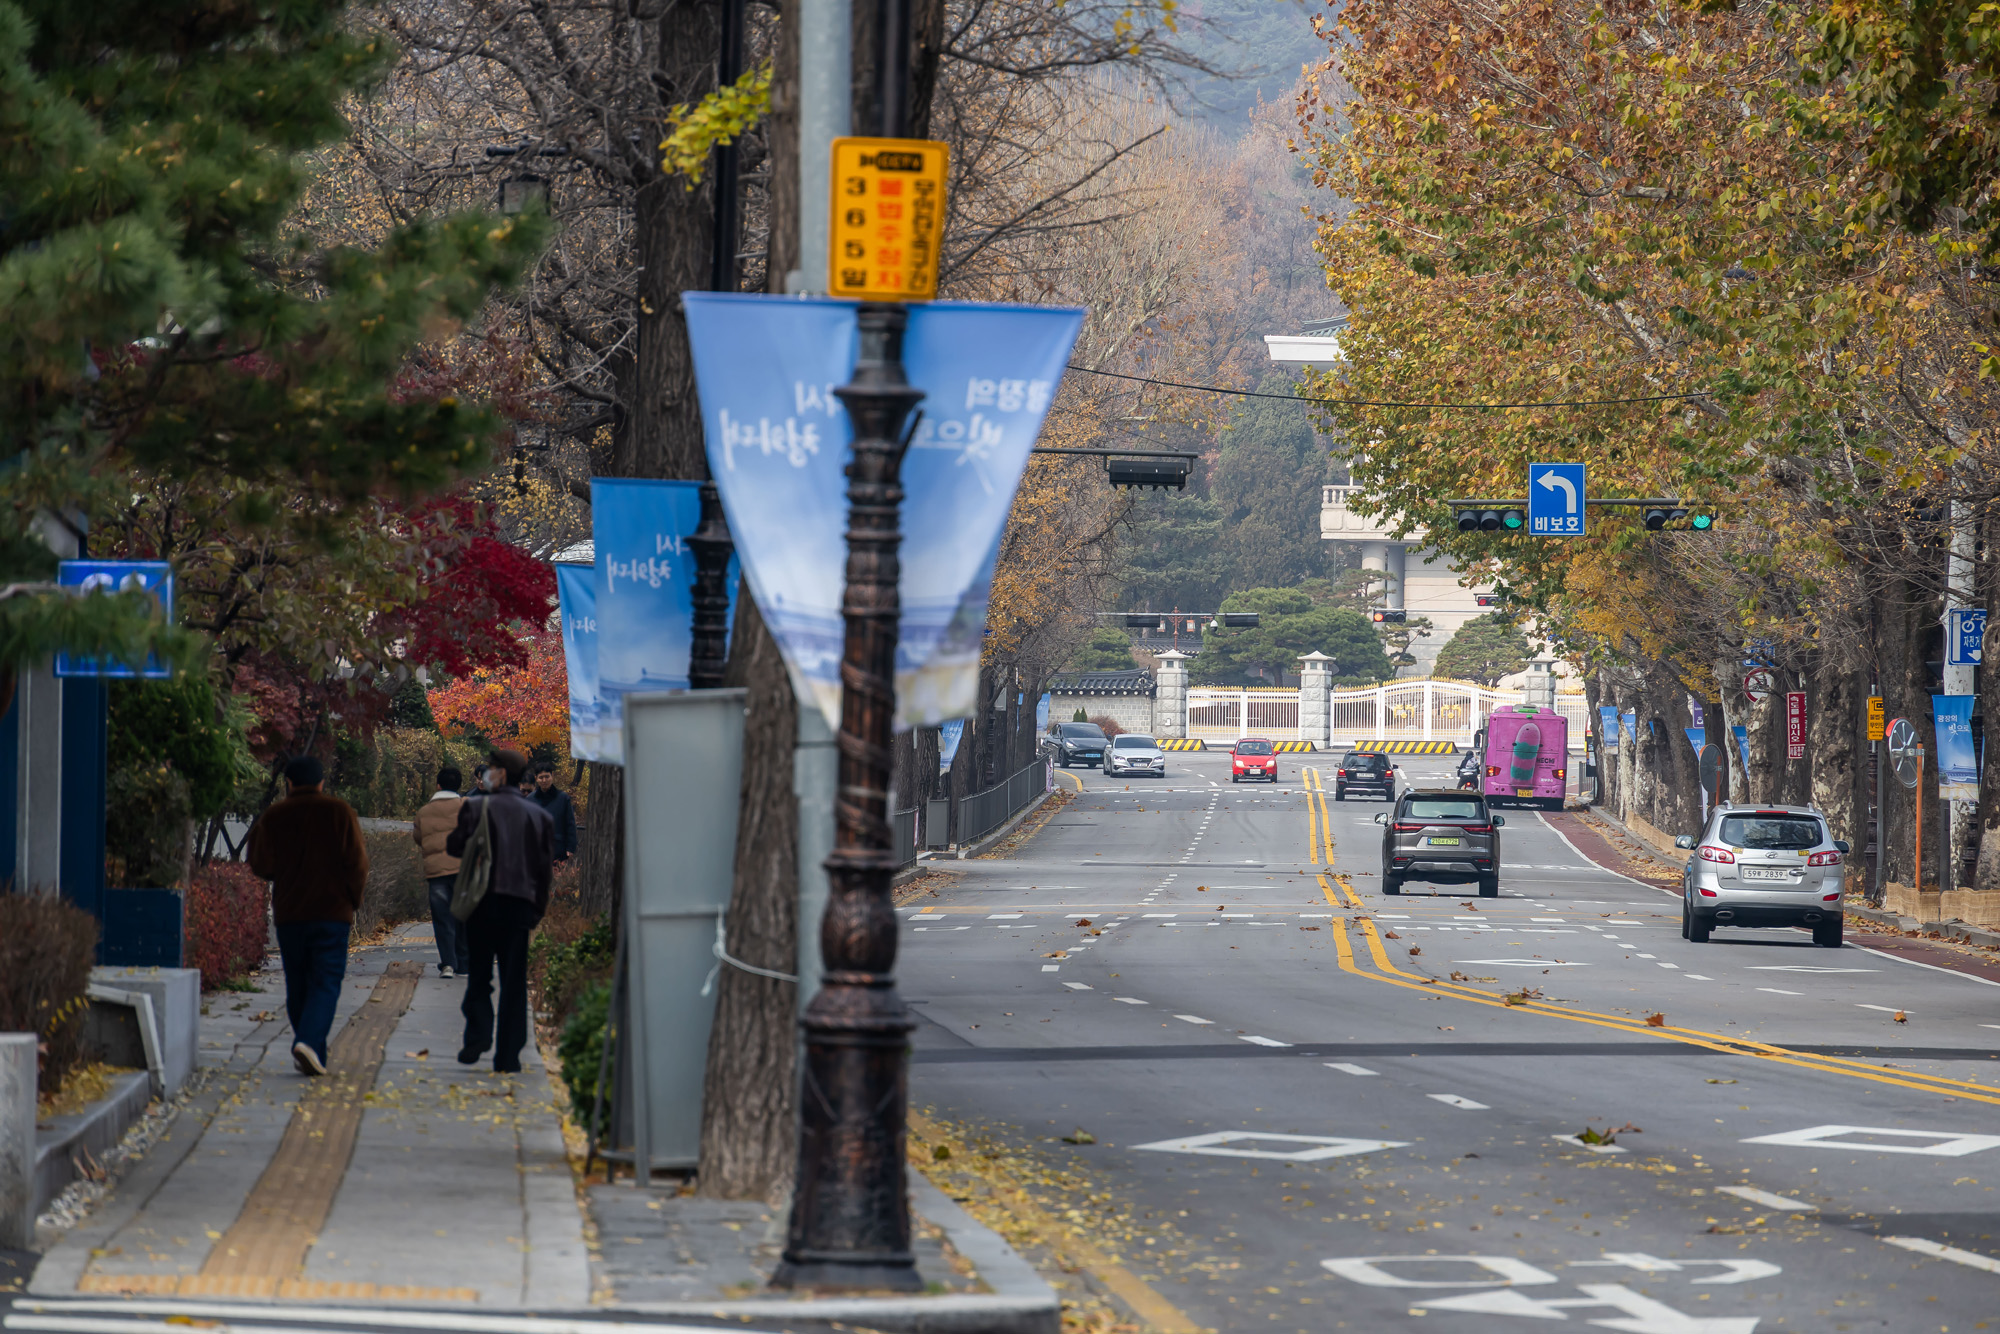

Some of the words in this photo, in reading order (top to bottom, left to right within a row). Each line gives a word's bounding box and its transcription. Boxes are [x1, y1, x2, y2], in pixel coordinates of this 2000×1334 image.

[1534, 516, 1579, 531] 비보호
[1963, 635, 1982, 648] 자전거
[1790, 695, 1800, 715] 속도를
[1937, 714, 1958, 723] 광장의
[1790, 717, 1800, 742] 줄이시오
[1948, 724, 1970, 741] 빛으로
[1764, 870, 1783, 878] 2839
